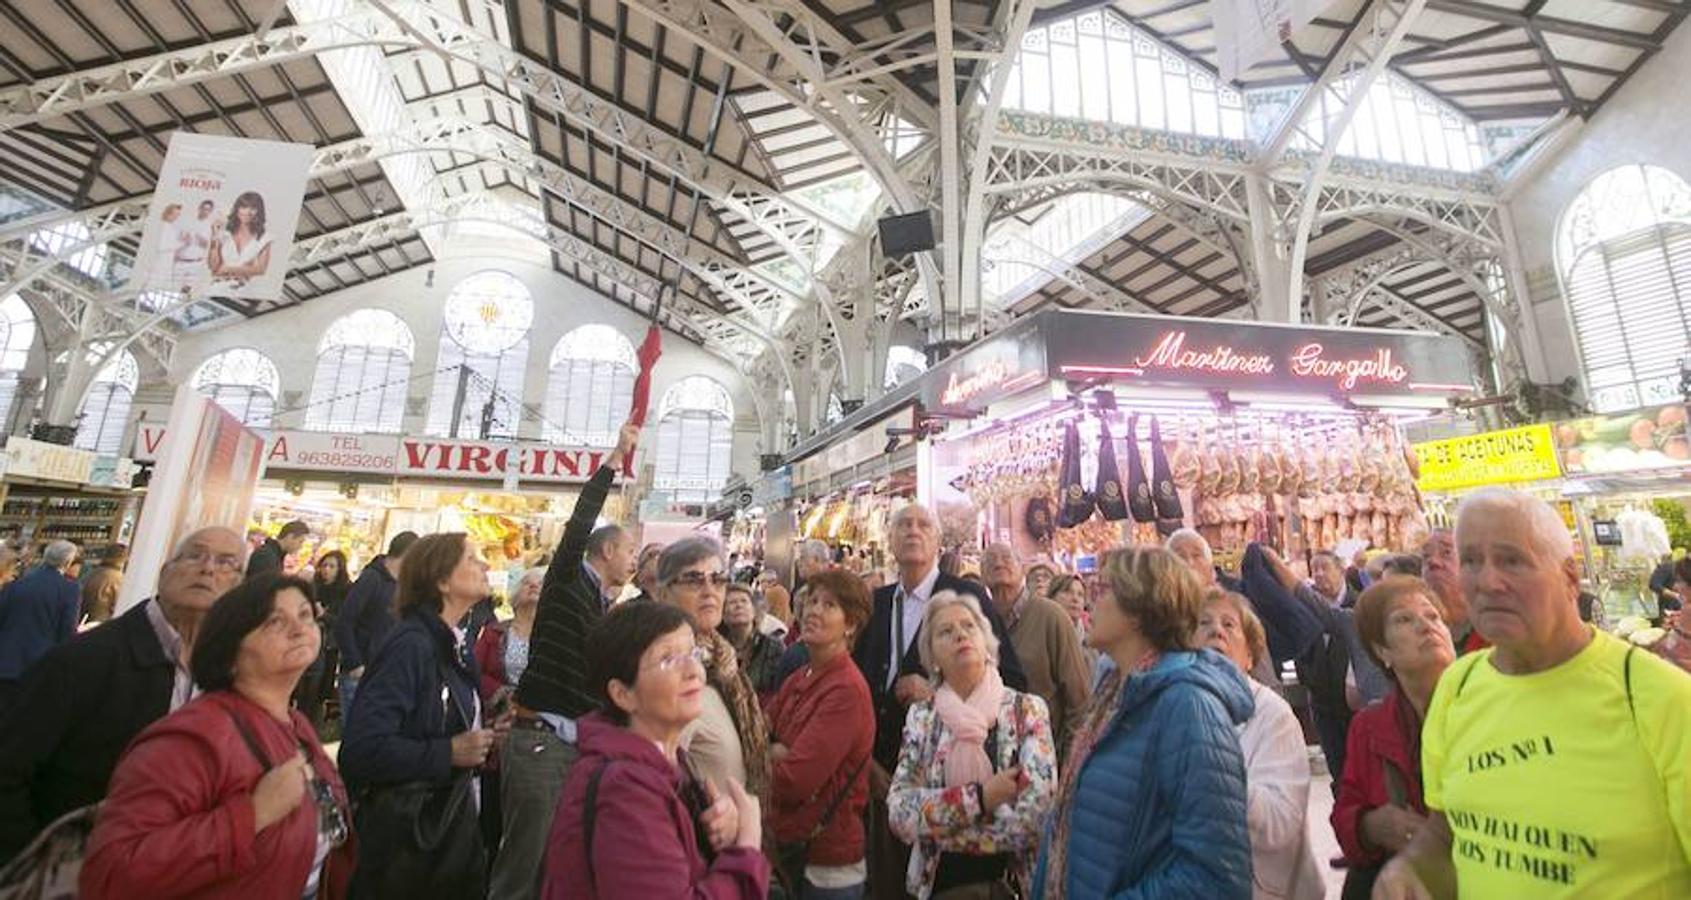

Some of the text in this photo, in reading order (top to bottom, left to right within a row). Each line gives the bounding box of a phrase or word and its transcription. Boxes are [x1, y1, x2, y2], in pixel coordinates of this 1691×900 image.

[1292, 343, 1407, 389] Gargallo
[296, 451, 394, 469] 963829206
[1459, 431, 1533, 459] ACEITUNAS
[1468, 747, 1506, 774] LOS
[1524, 825, 1597, 859] QUEN
[1494, 848, 1575, 884] TUMBE
